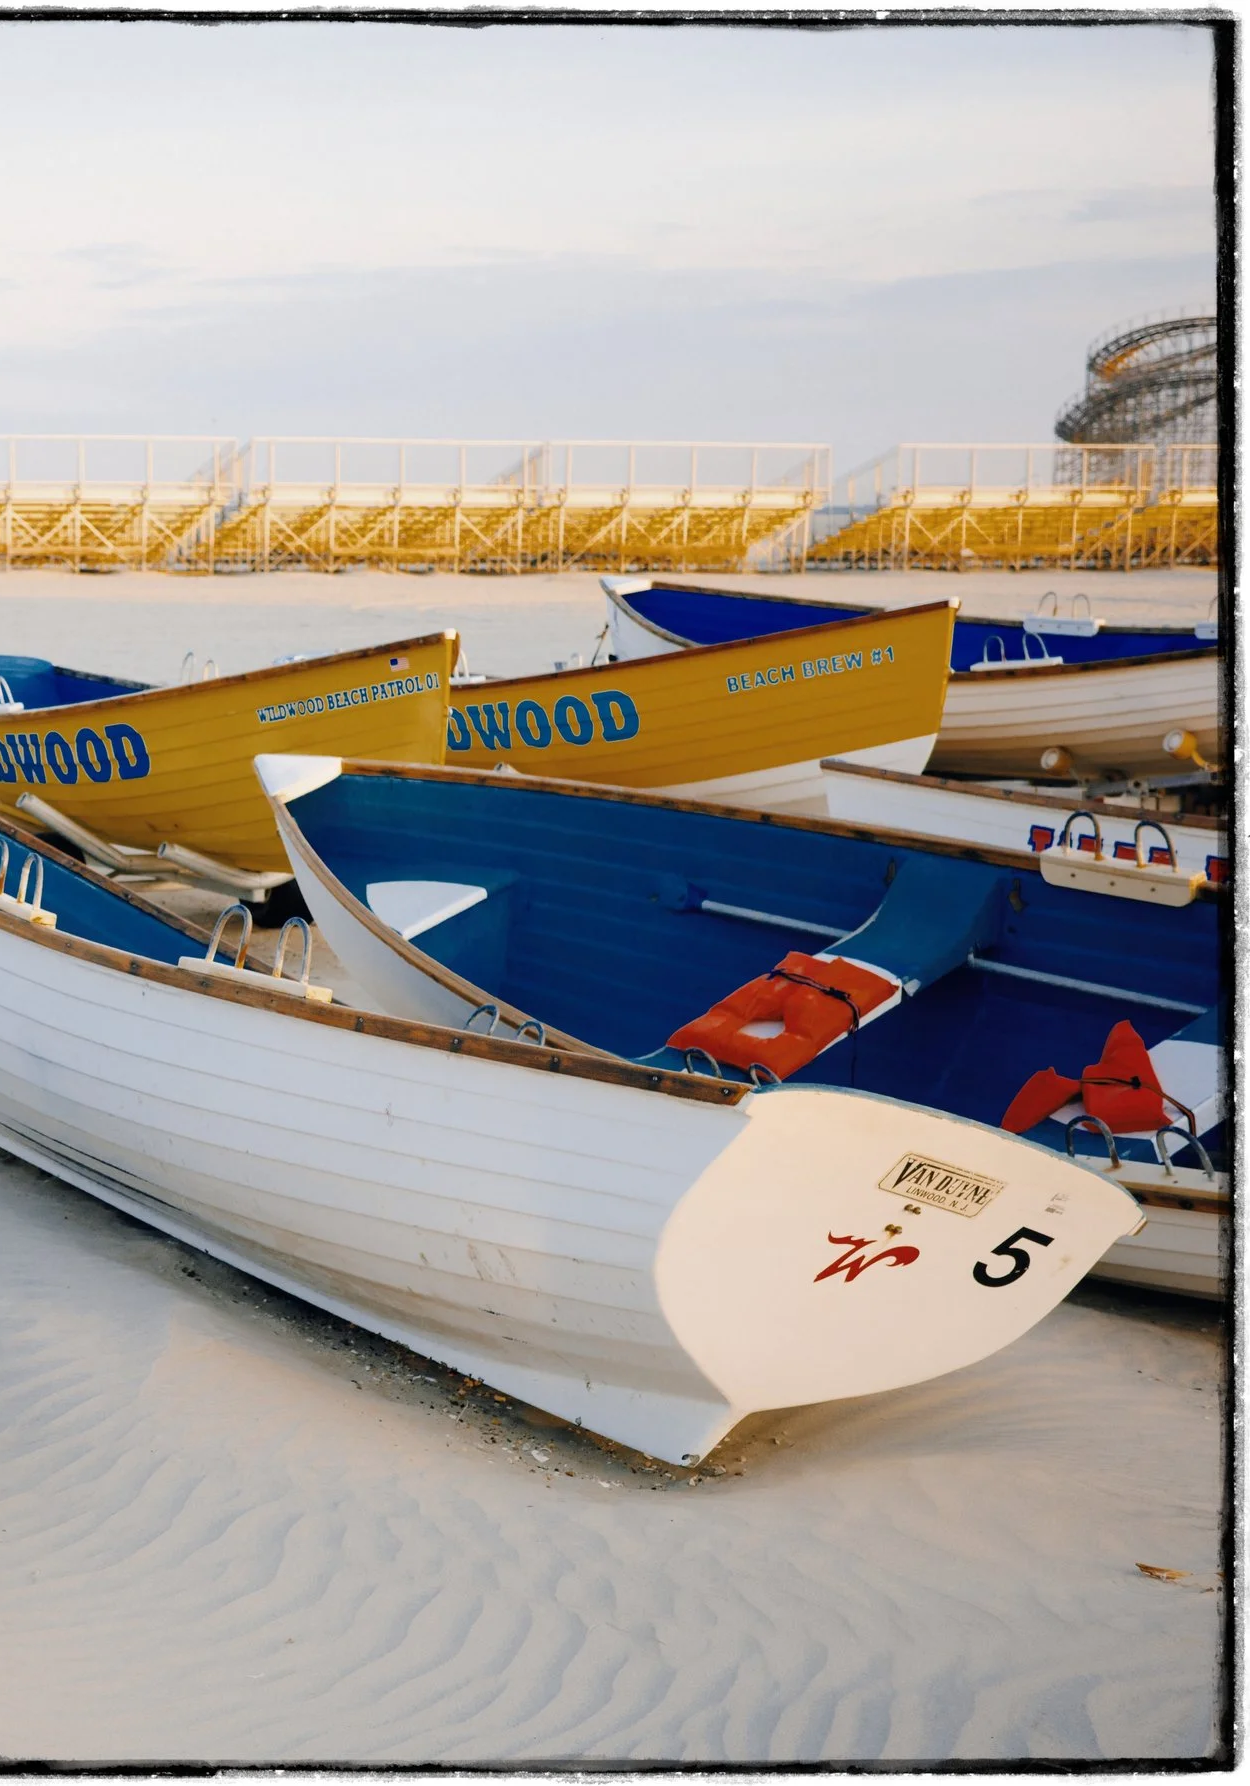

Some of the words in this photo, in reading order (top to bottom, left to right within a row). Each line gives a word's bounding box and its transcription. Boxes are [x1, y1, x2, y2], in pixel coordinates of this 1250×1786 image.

[726, 664, 795, 693] BEACH
[801, 651, 863, 679] BREW
[870, 645, 895, 666] #1
[256, 697, 324, 723] WILDWOOD
[326, 687, 369, 710] BEACH
[371, 675, 423, 701] PATROL
[425, 672, 440, 689] 01
[892, 1157, 939, 1189] VAN
[933, 1174, 991, 1206] DUYNE
[972, 1226, 1055, 1288] 5
